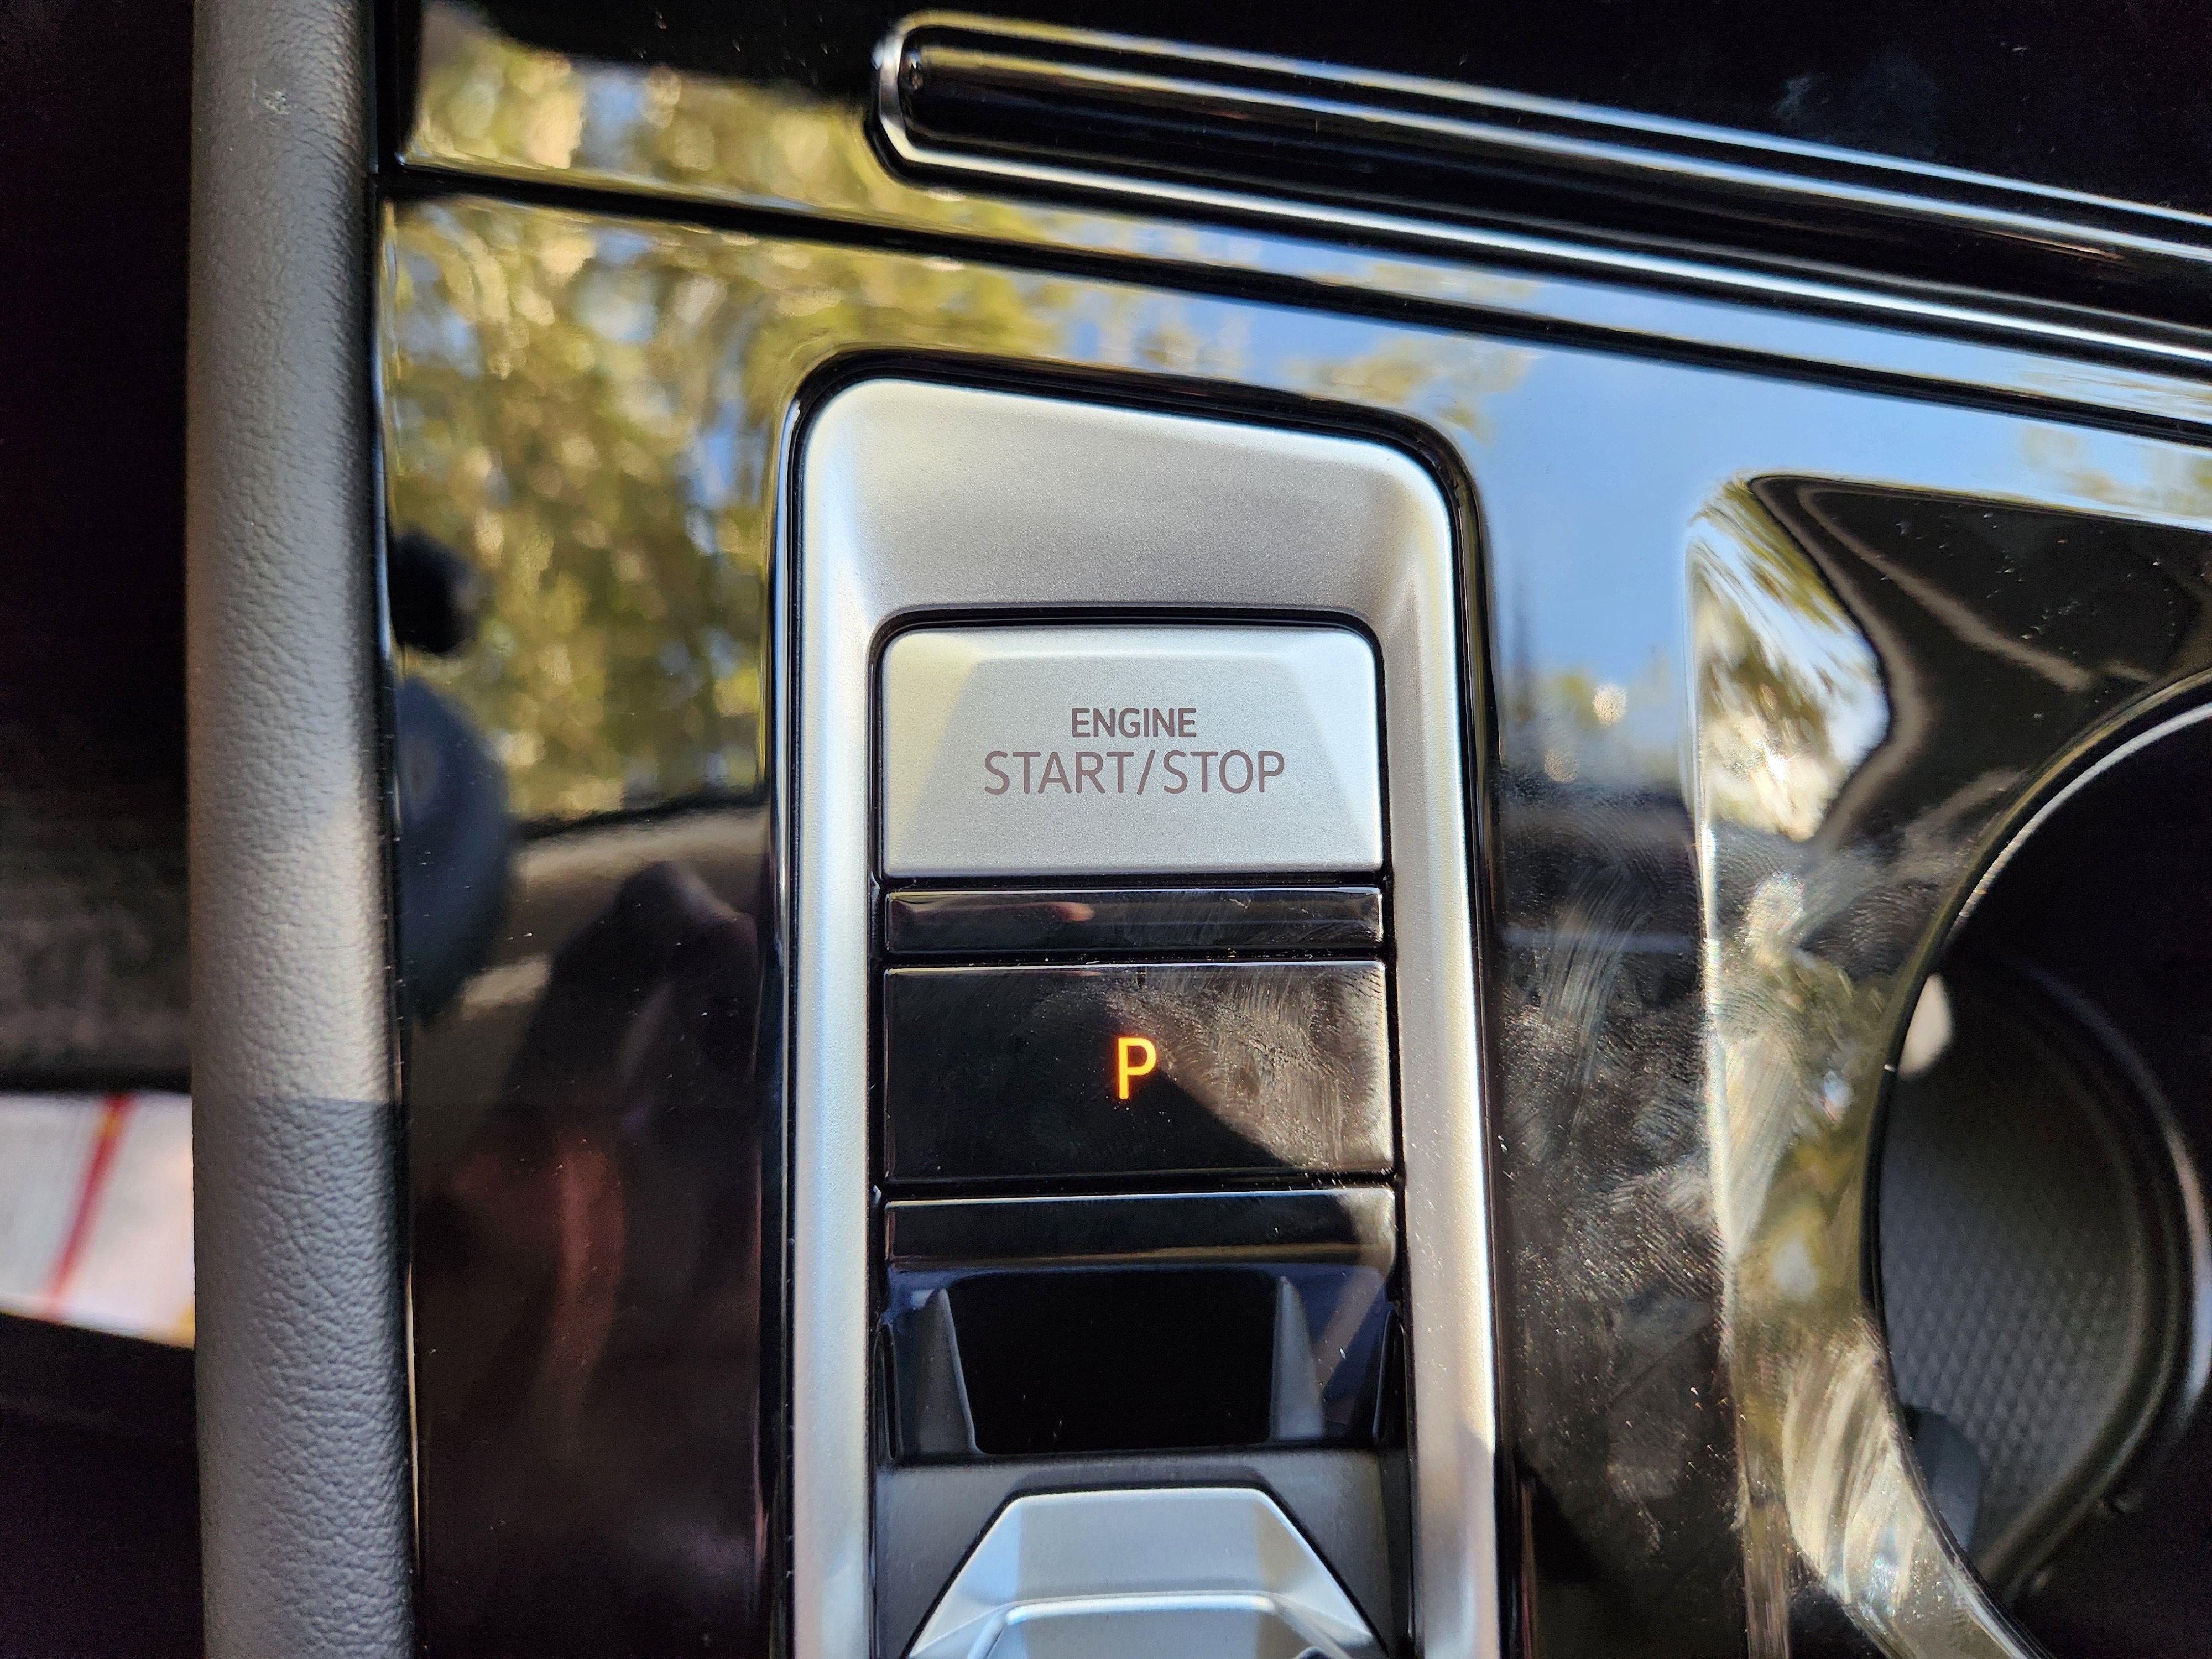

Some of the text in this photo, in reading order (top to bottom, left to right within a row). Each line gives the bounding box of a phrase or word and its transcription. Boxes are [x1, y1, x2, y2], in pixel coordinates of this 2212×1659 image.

[1072, 708, 1196, 738] ENGINE
[984, 750, 1285, 795] START/STOP
[1118, 1036, 1157, 1100] P
